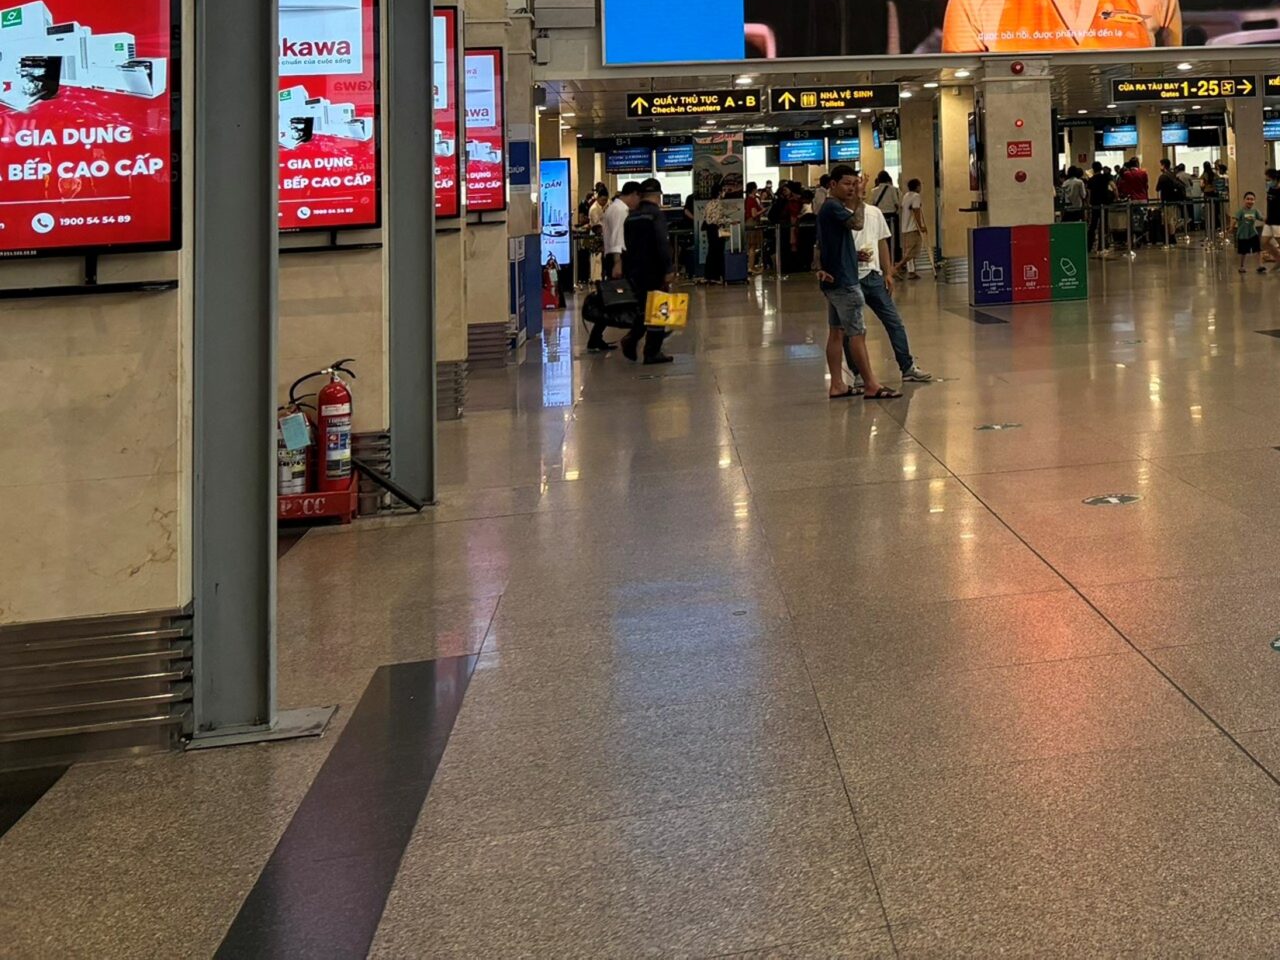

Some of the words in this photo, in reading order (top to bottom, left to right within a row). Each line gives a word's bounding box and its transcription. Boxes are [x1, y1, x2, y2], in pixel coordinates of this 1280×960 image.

[278, 37, 351, 57] kawa
[820, 90, 839, 100] NHÀ
[853, 90, 873, 99] SINH
[1135, 83, 1147, 91] RA
[1147, 82, 1163, 90] TÀU
[1180, 80, 1219, 97] 1-25
[1160, 90, 1180, 98] Gates
[679, 93, 699, 104] THỦ
[700, 95, 718, 105] TỤC
[724, 95, 736, 108] A
[745, 95, 756, 108] B
[820, 100, 845, 108] Toilets
[651, 104, 686, 114] Check-in
[686, 104, 721, 113] Counters
[15, 128, 57, 147] GIA
[62, 125, 132, 149] DỤNG
[8, 157, 52, 181] BẾP
[57, 160, 109, 179] CAO
[114, 153, 163, 177] CẤP
[287, 159, 312, 169] GIA
[314, 156, 354, 172] DỤNG
[283, 175, 309, 189] BẾP
[311, 176, 341, 188] CAO
[343, 172, 372, 187] CẤP
[60, 217, 84, 226] 1900
[86, 216, 100, 225] 54
[102, 216, 115, 224] 54
[117, 215, 131, 224] 89
